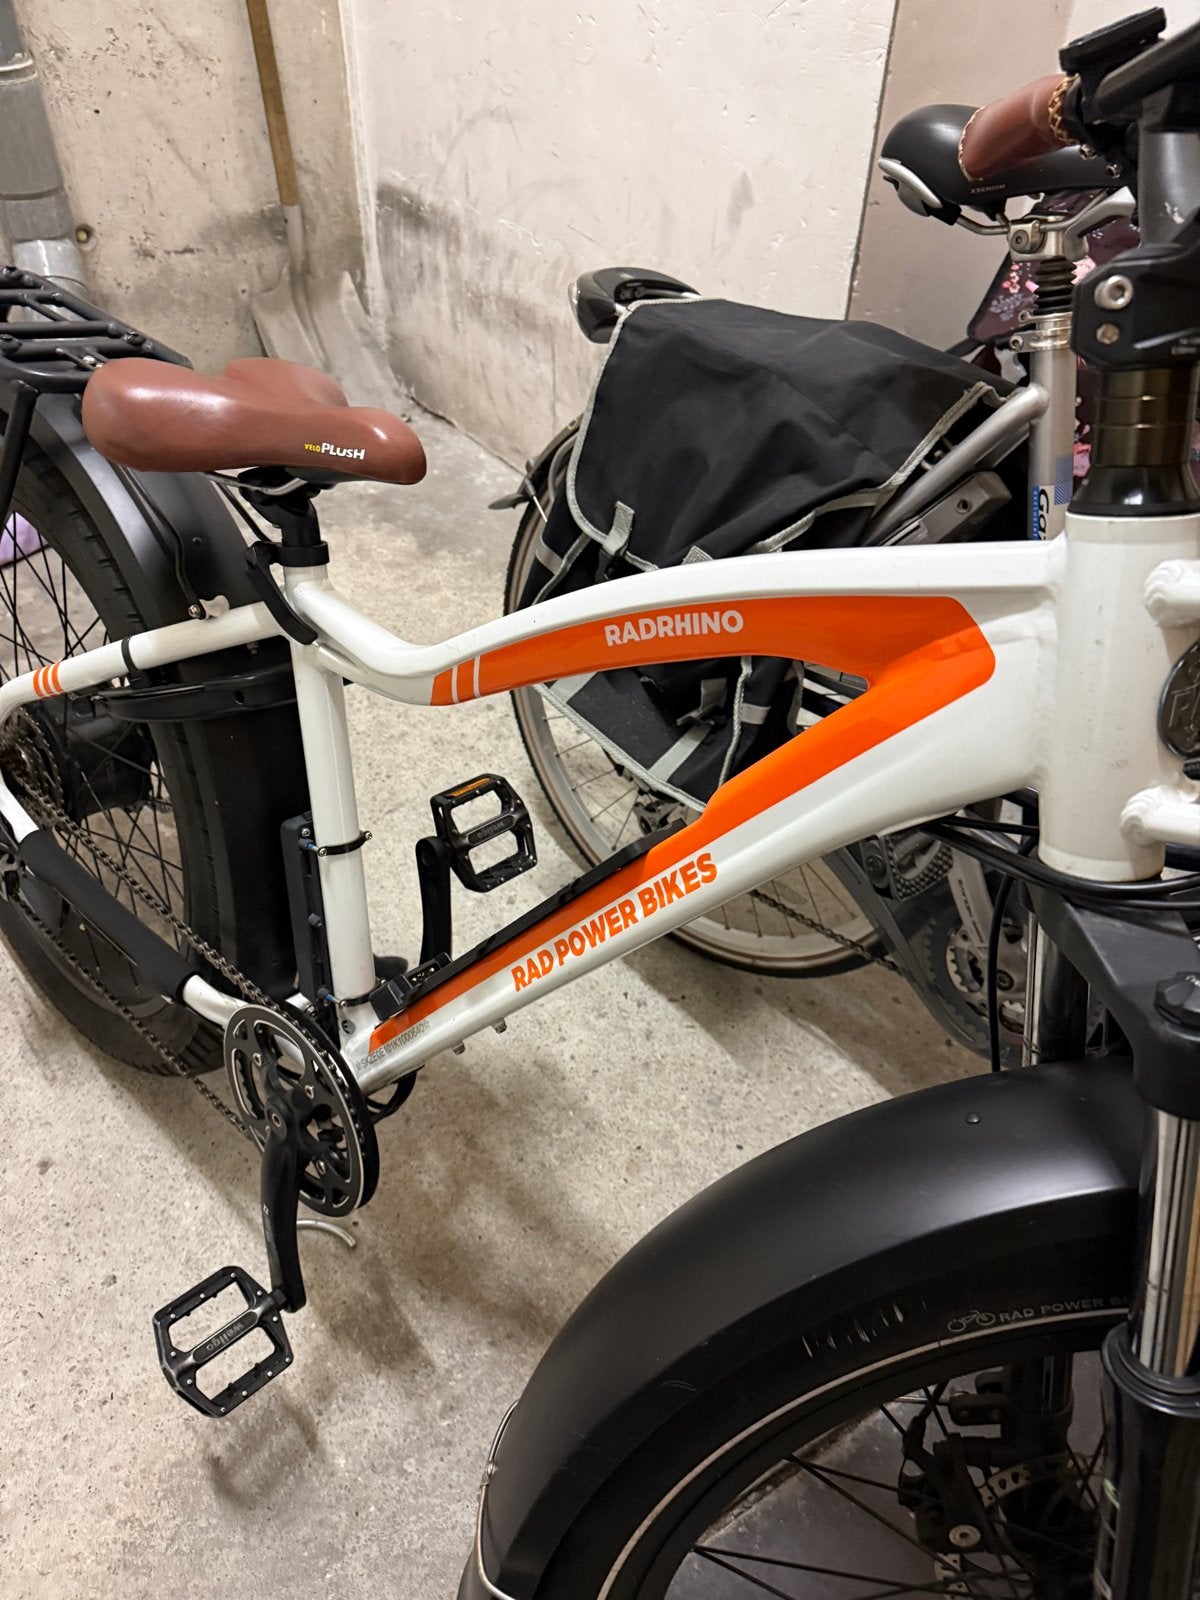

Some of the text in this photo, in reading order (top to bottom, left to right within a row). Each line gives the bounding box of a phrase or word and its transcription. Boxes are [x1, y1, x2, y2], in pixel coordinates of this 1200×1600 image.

[304, 442, 366, 459] VELO PLUSH
[604, 610, 744, 647] RADRHINO
[511, 852, 718, 992] RAD POWER BIKES
[1000, 1308, 1034, 1322] RAD
[1041, 1298, 1104, 1314] POWER
